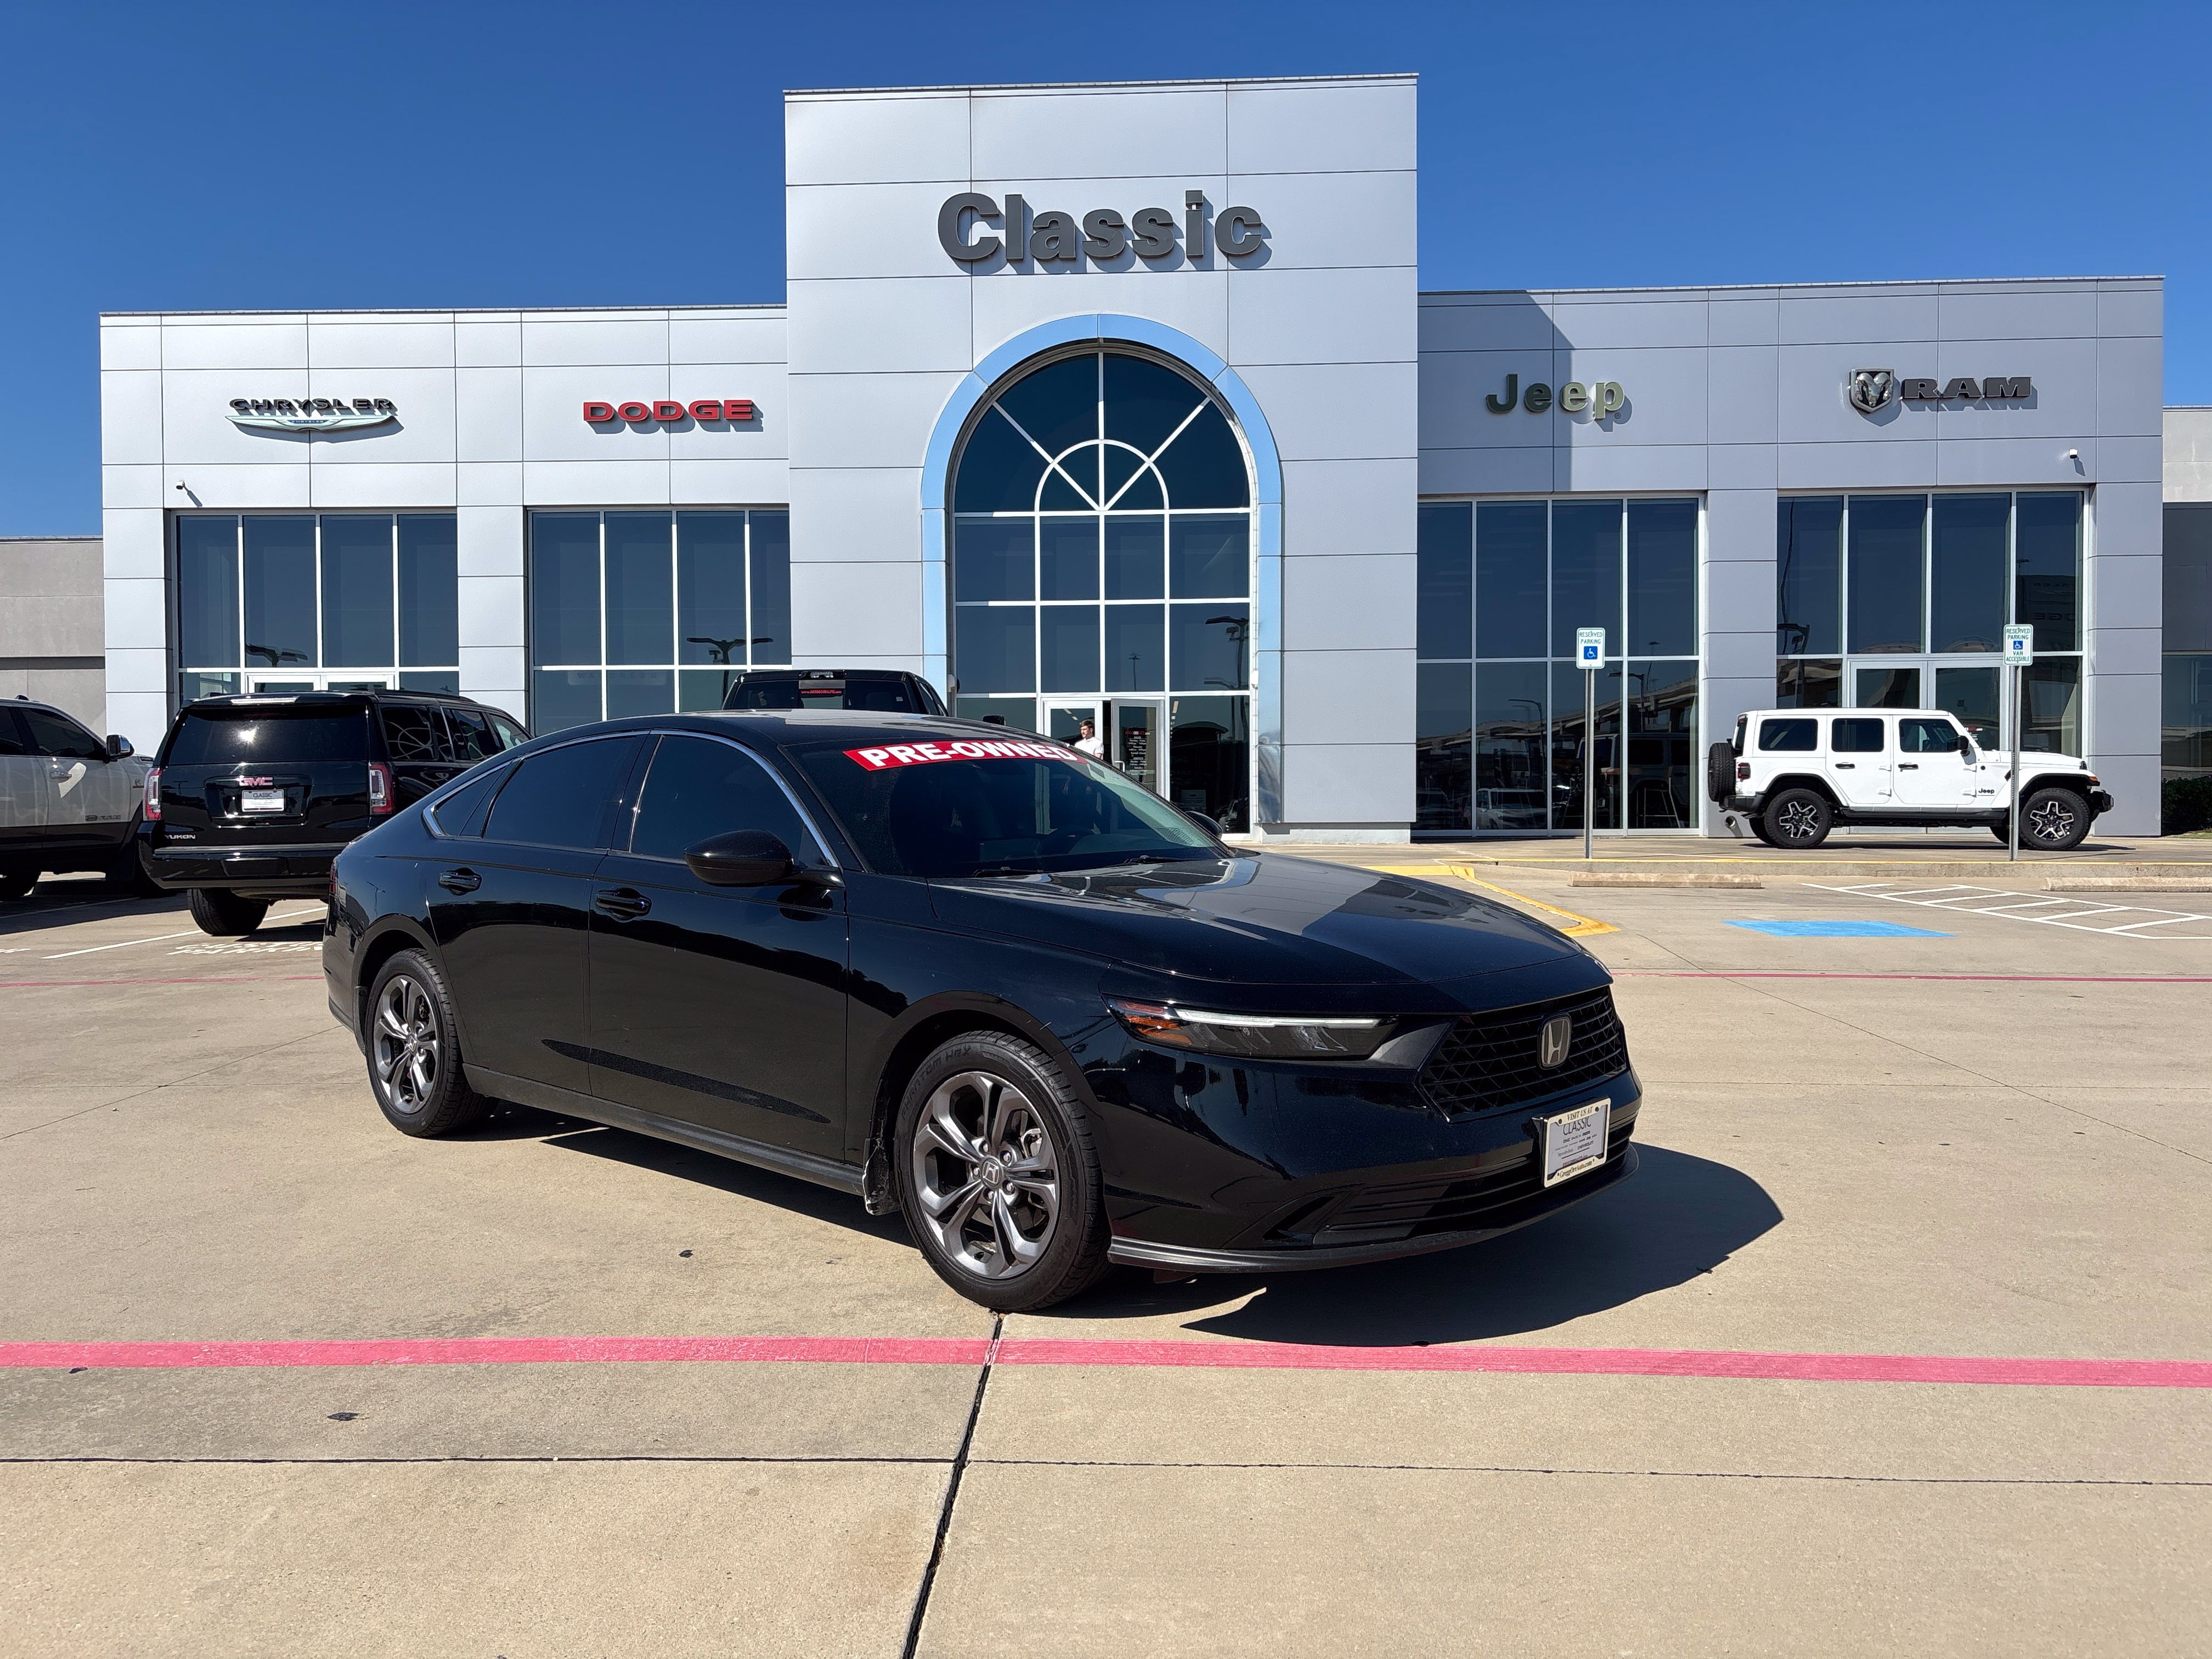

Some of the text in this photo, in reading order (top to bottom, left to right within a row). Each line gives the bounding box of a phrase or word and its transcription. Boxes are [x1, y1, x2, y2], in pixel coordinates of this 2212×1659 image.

[937, 190, 1262, 261] Classic
[1485, 373, 1625, 419] Jeep
[1901, 376, 2033, 399] RAM
[229, 398, 391, 410] CHRYSLER
[583, 400, 752, 421] DODGE
[858, 742, 1078, 767] PRE-OWNED
[239, 777, 273, 786] GMC
[1567, 1110, 1580, 1121] VISIT
[1580, 1108, 1587, 1116] US
[1563, 1116, 1592, 1135] CLASSIC
